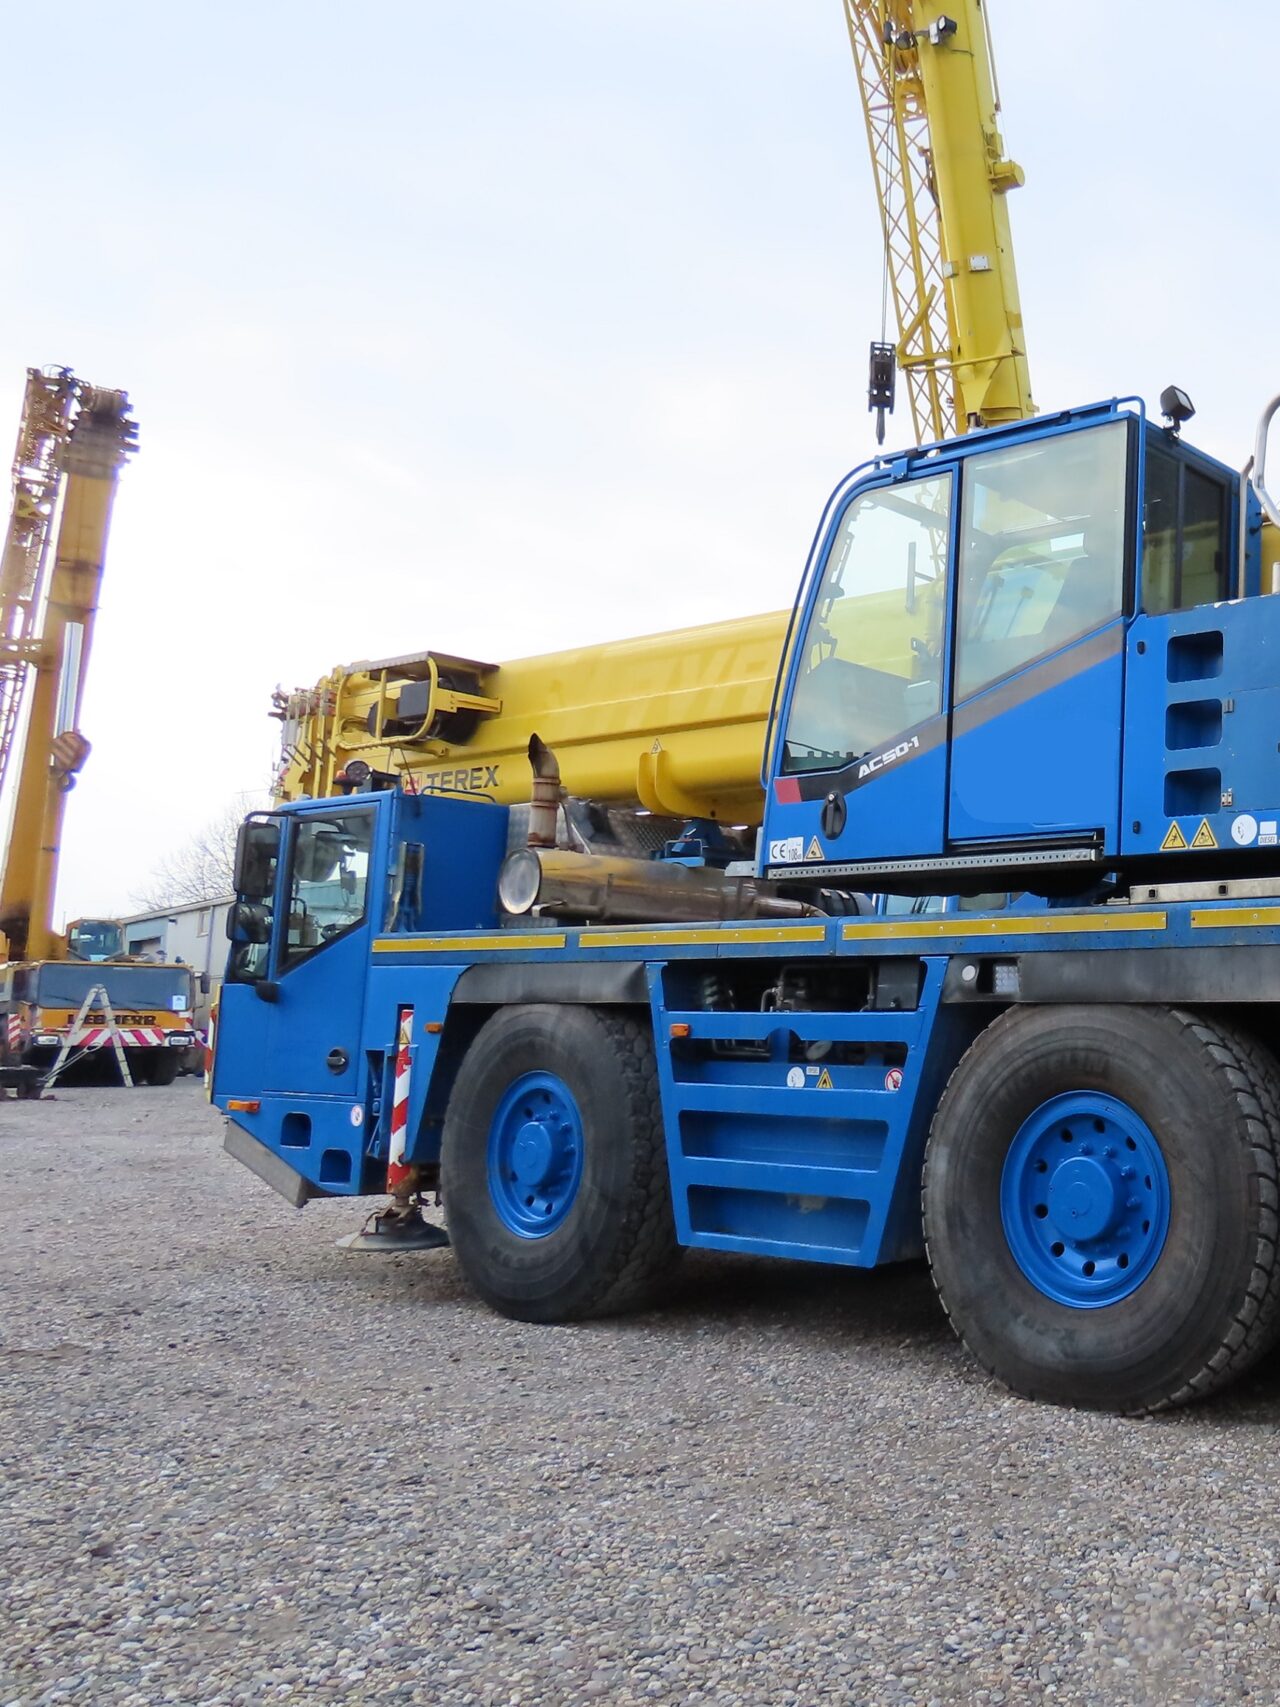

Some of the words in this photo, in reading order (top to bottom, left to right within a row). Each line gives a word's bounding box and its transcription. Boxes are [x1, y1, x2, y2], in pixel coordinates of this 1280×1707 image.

[858, 735, 920, 779] AC50-1
[427, 765, 500, 794] TEREX
[67, 1014, 156, 1026] LEBHERR
